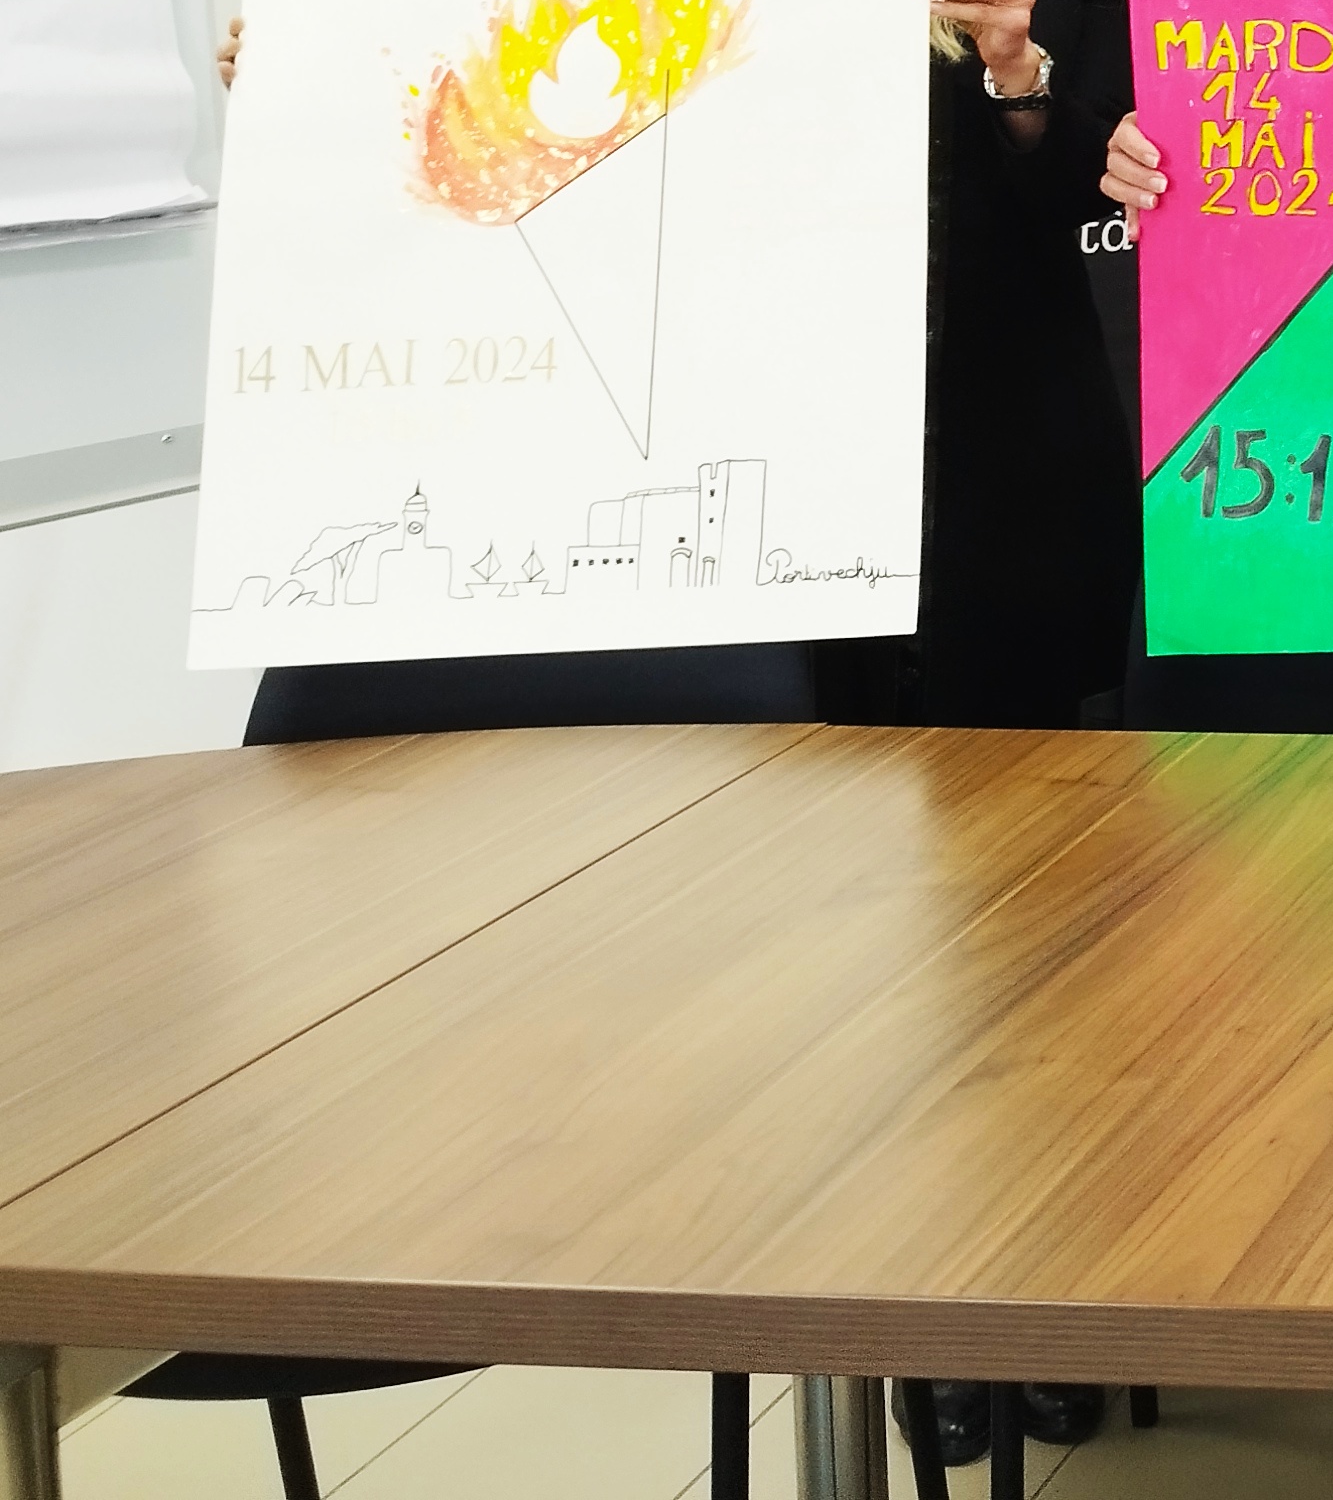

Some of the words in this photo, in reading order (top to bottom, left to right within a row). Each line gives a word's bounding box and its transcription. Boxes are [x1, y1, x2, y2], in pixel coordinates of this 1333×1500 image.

[1201, 71, 1282, 121] 14
[233, 345, 277, 395] 14
[301, 339, 417, 393] MAI
[443, 336, 558, 386] 2024
[765, 547, 891, 590] Portivechju
